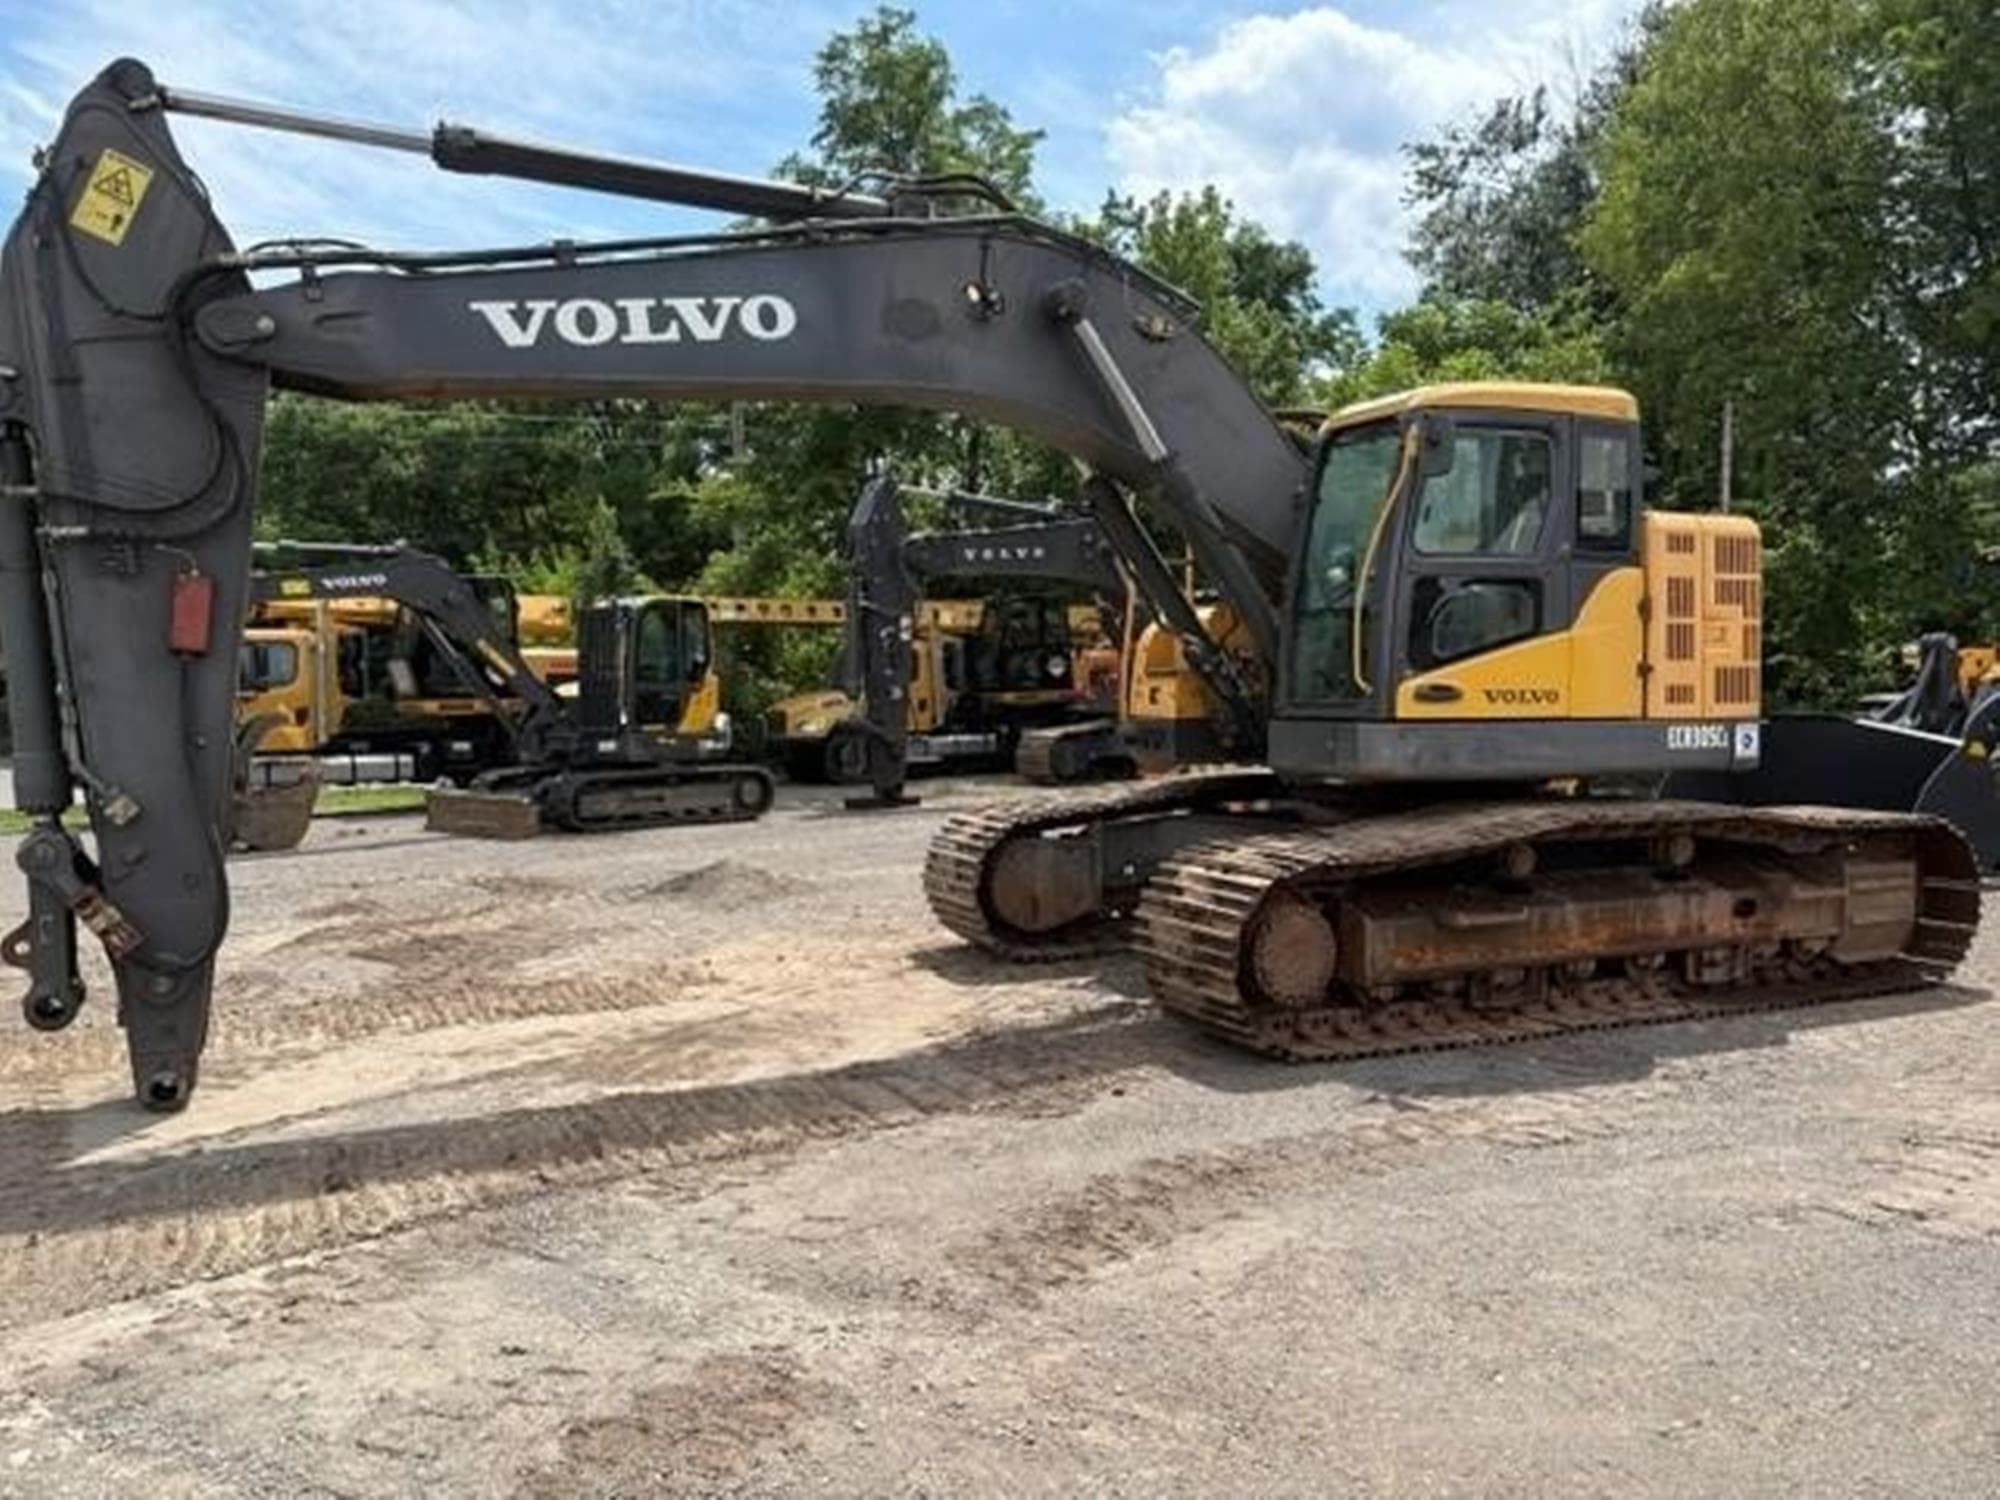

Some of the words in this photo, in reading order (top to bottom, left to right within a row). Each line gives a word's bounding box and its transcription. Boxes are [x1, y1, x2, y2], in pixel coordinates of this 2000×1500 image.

[469, 294, 796, 347] VOLVO
[963, 547, 1045, 561] VOLVO
[321, 573, 387, 591] VOLVO
[1484, 688, 1560, 704] VOLVO
